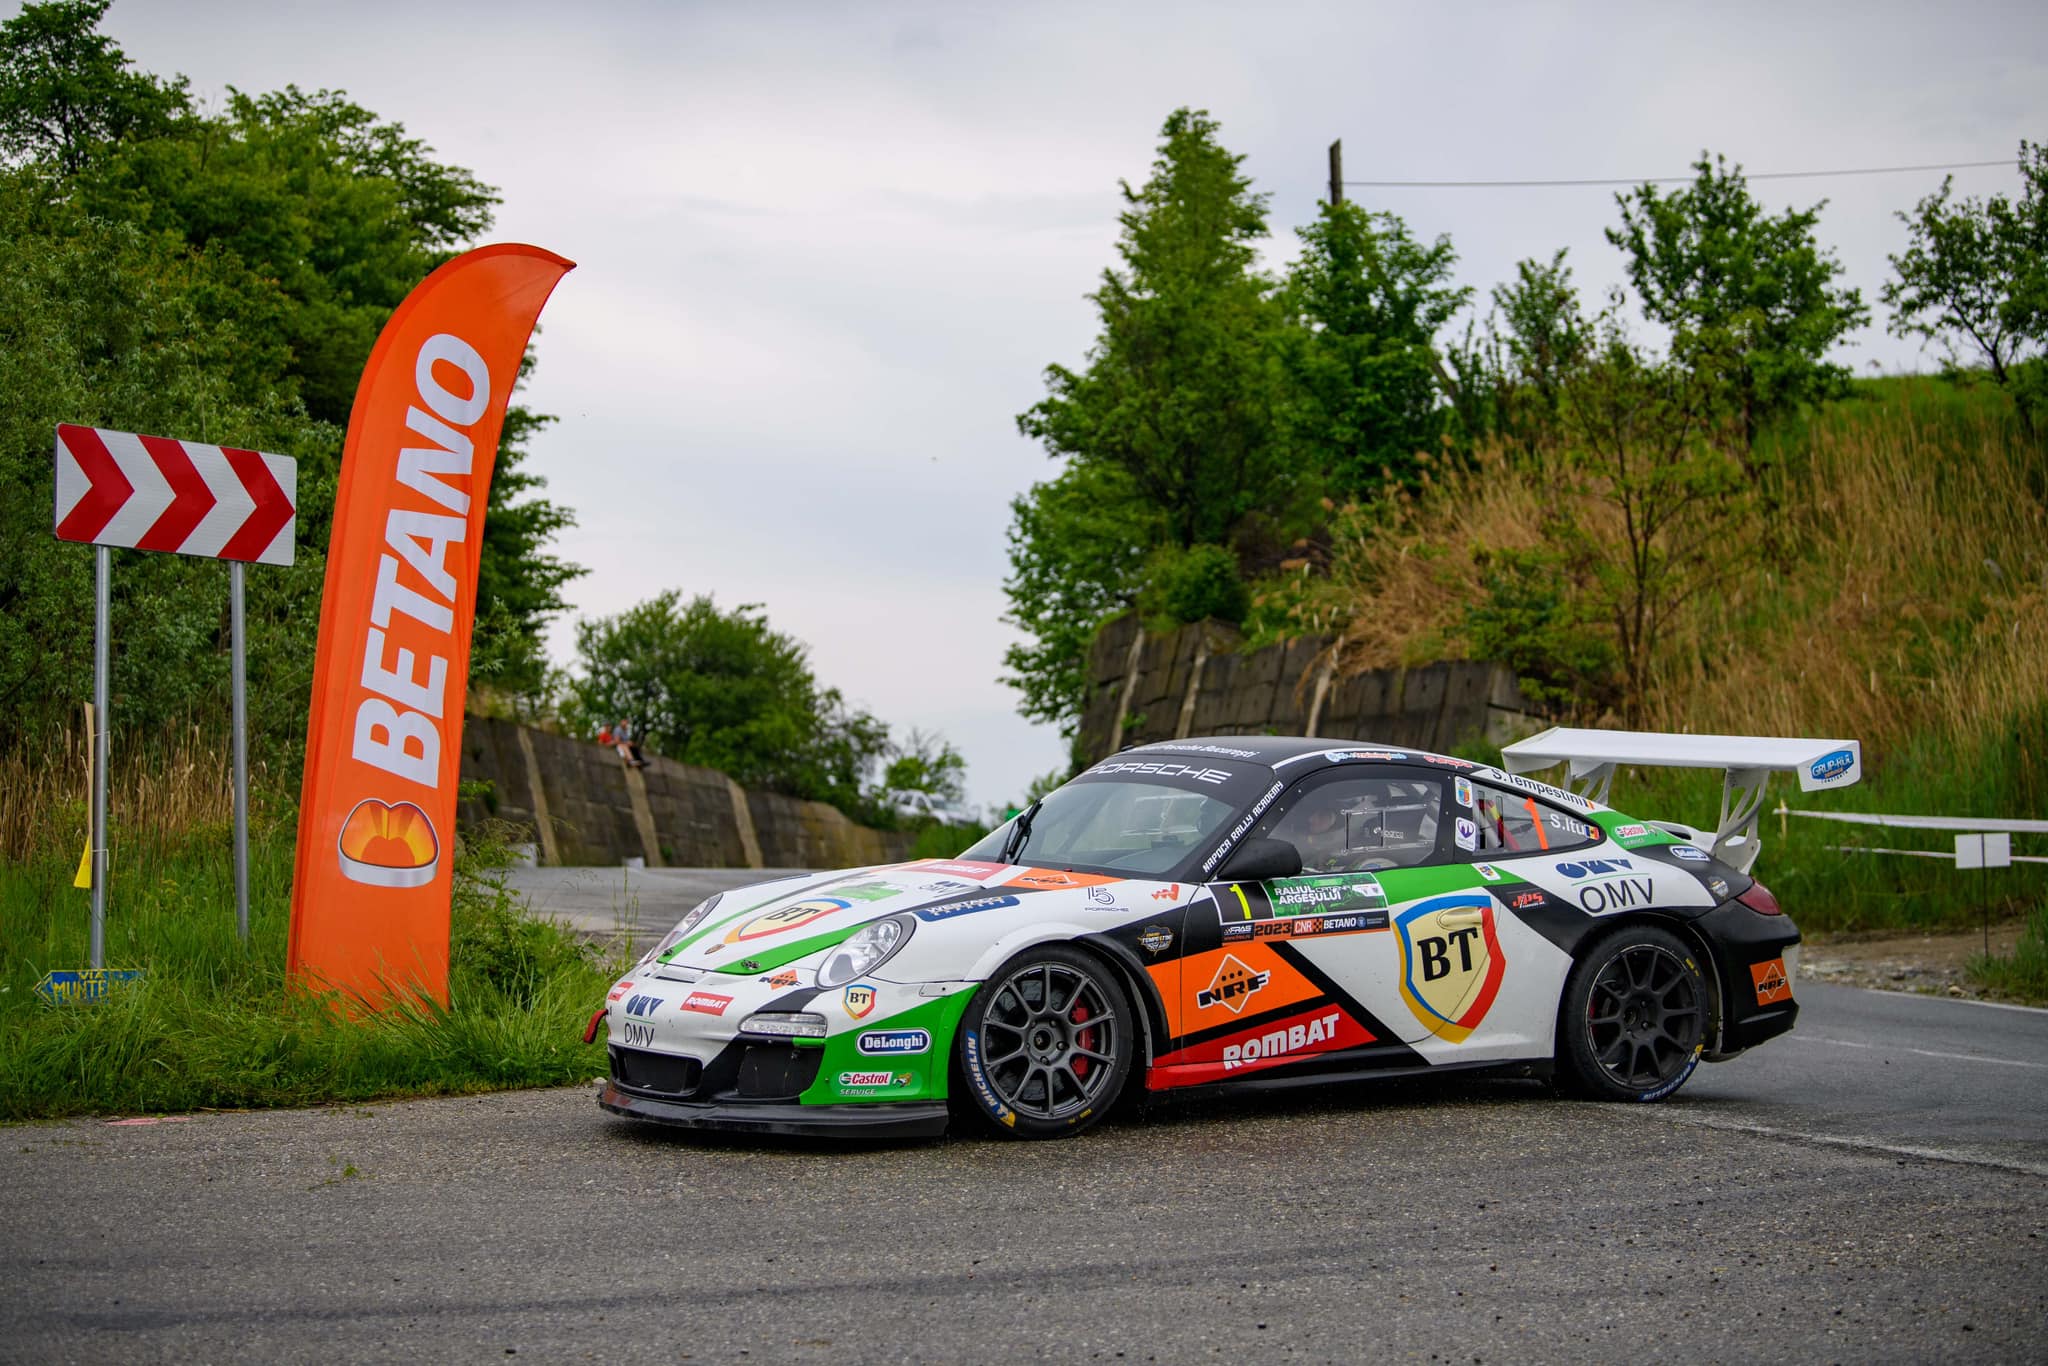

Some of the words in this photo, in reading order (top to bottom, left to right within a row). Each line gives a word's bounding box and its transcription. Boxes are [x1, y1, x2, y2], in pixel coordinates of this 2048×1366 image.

[352, 333, 490, 788] BETANO
[1087, 762, 1233, 785] PORSCHE
[1202, 839, 1232, 873] NAPOCA
[1231, 815, 1253, 842] RALLY
[1253, 780, 1284, 818] ACADEMY
[1228, 883, 1252, 920] 1
[1274, 885, 1315, 896] RALIUL
[1579, 878, 1653, 914] OMV
[1254, 922, 1291, 936] 2023
[1294, 921, 1313, 934] CNR
[1323, 917, 1357, 929] BETANO
[1416, 927, 1478, 981] BT
[850, 992, 870, 1004] BT
[1199, 971, 1269, 1007] NRF
[624, 1022, 655, 1048] OMV
[1223, 1013, 1340, 1071] ROMBAT
[852, 1072, 889, 1085] Castrol
[967, 1036, 997, 1107] MICHELIN
